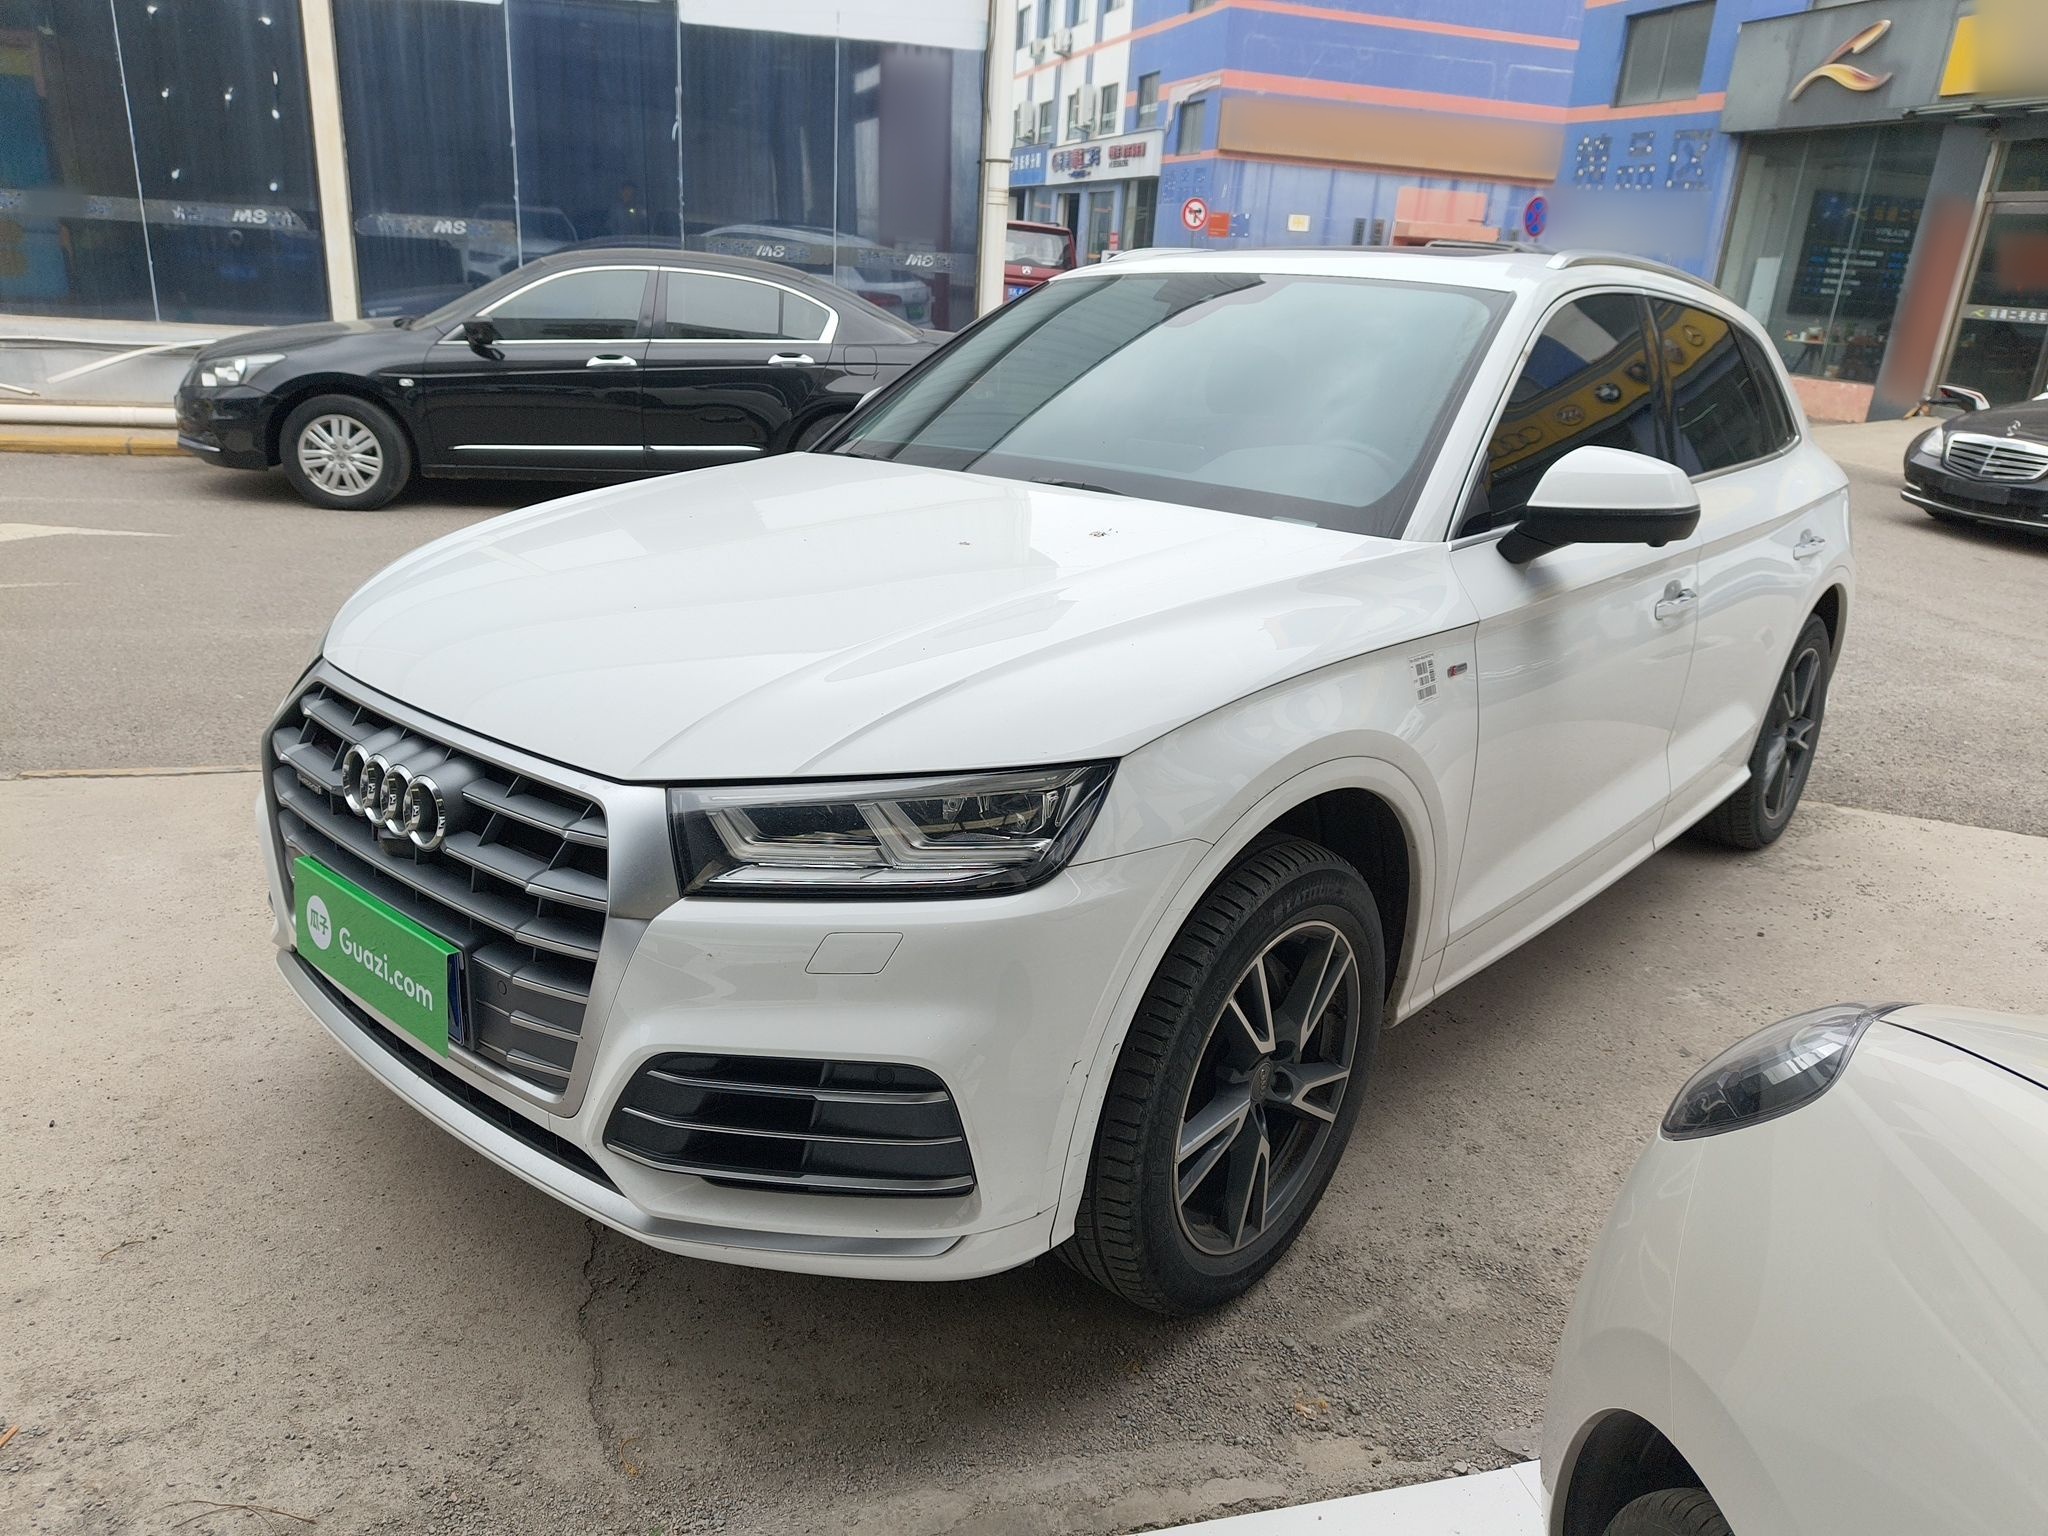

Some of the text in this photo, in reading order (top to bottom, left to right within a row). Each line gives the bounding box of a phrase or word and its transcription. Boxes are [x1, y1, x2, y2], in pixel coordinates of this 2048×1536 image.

[433, 220, 467, 235] MS
[310, 908, 329, 936] 瓜子
[339, 927, 433, 1012] Guazi.com
